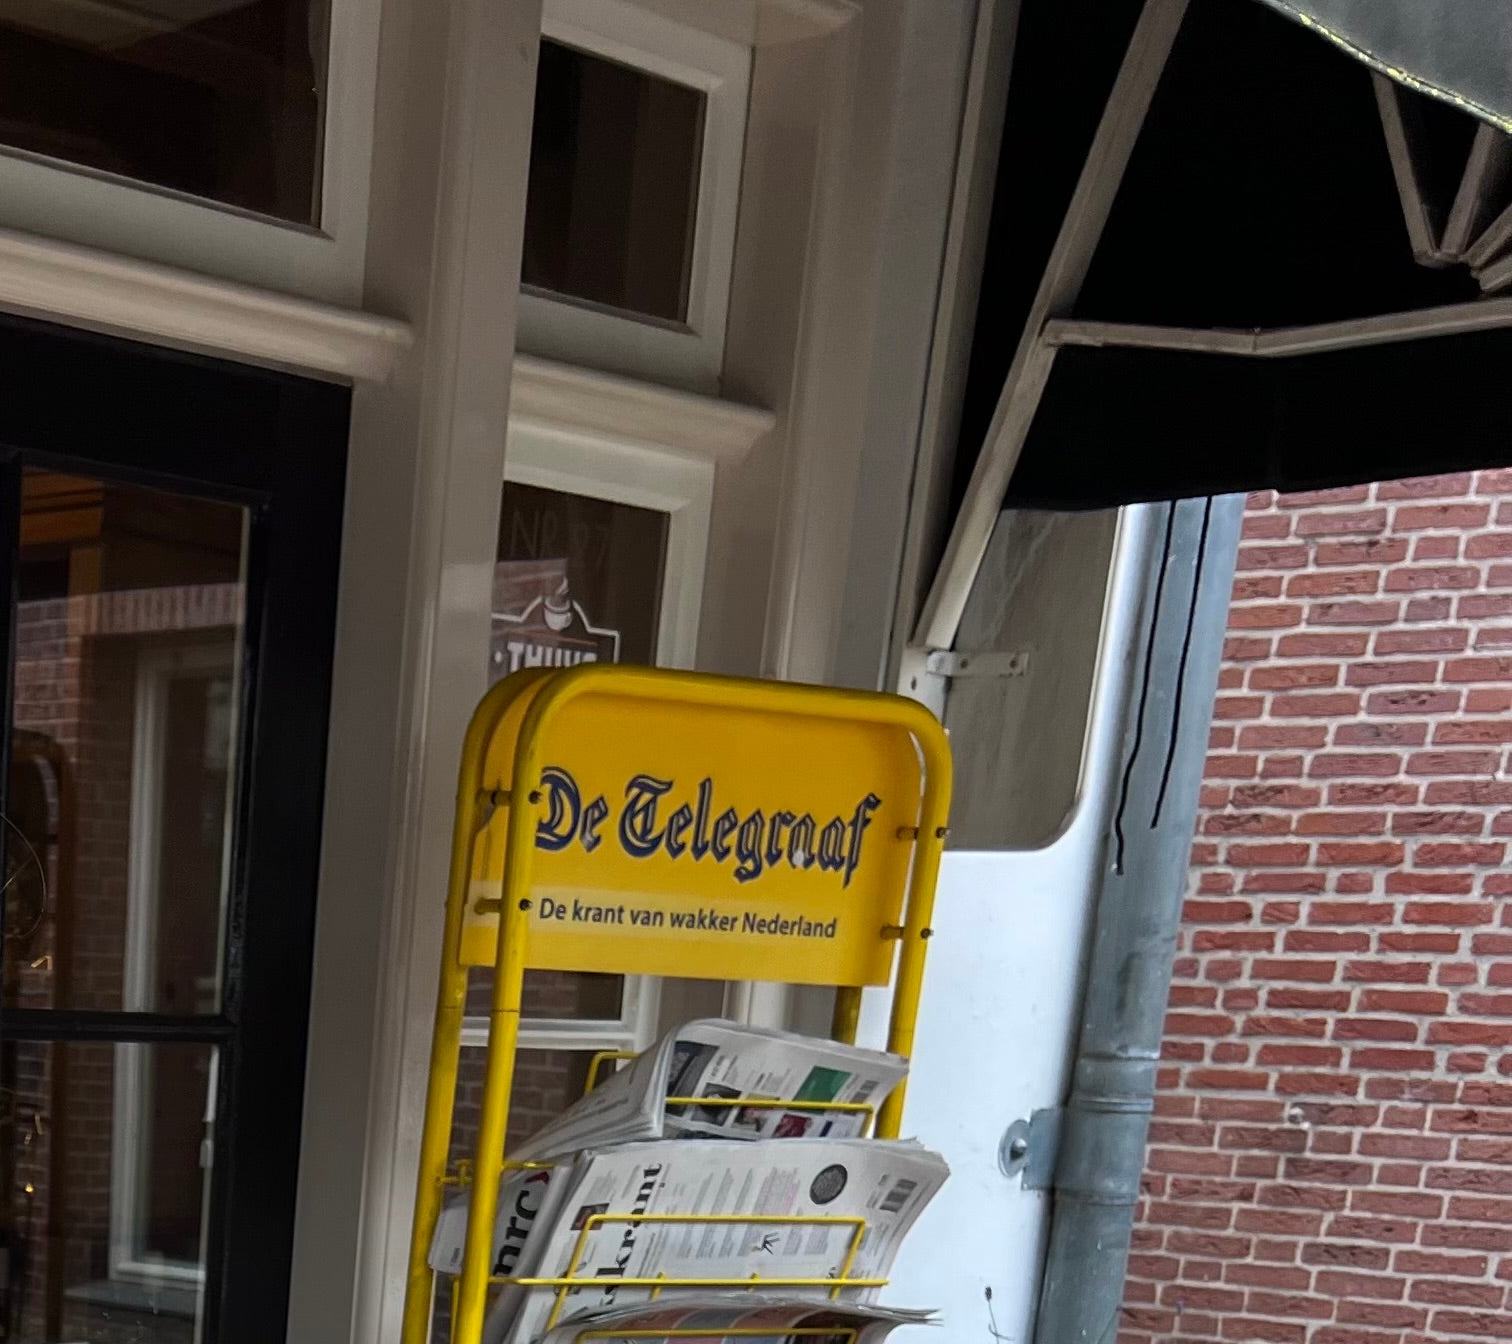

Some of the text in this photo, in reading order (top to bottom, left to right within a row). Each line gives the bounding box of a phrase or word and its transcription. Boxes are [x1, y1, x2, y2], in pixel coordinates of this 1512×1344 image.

[535, 766, 881, 888] De Telegraaf
[539, 897, 837, 939] De krant van wakker Nederland
